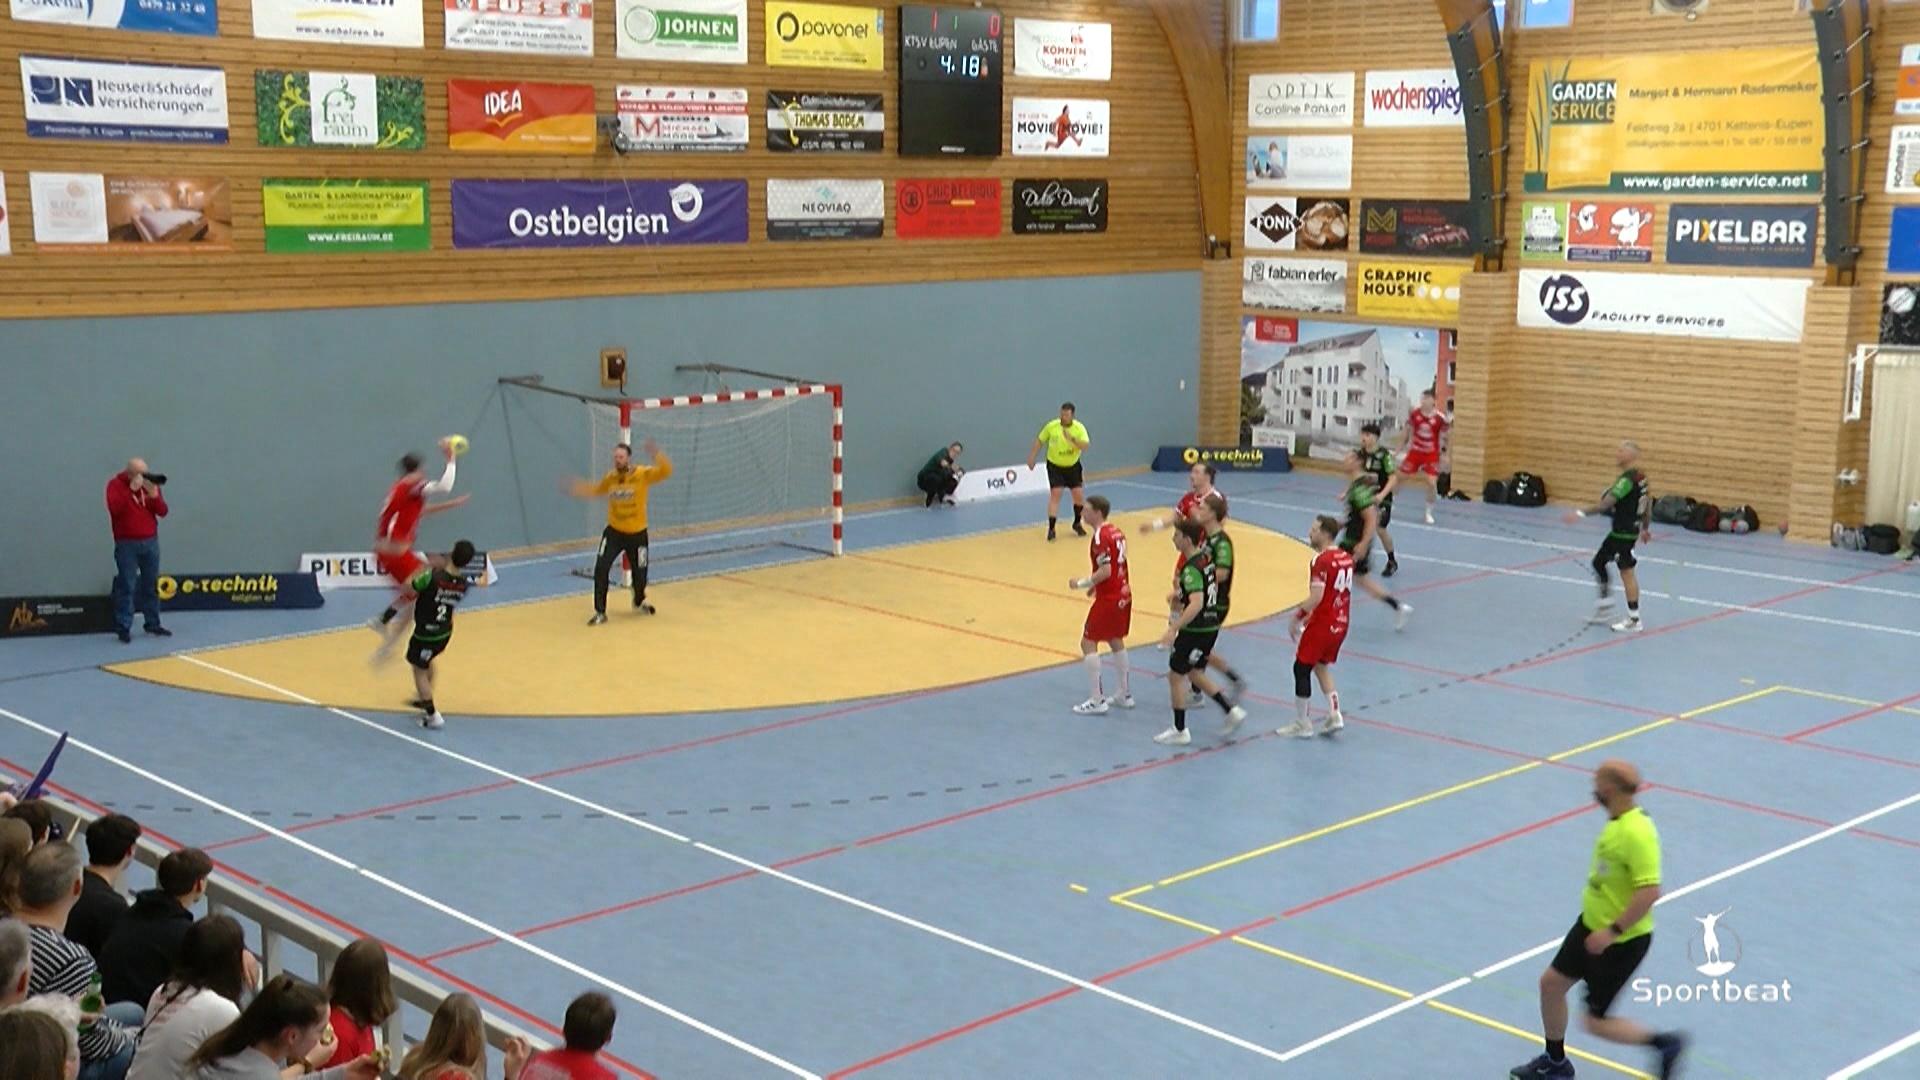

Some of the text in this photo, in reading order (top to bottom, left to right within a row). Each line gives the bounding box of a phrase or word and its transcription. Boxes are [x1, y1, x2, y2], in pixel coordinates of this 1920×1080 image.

[664, 17, 735, 37] JOHNEN
[802, 20, 868, 38] pavonet
[1268, 82, 1334, 101] OPTIK
[1552, 81, 1616, 101] GARDEN
[1629, 88, 1669, 100] Margot
[1672, 86, 1680, 97] &
[1683, 85, 1738, 97] Hermann
[97, 97, 205, 115] Versicherungen
[484, 88, 523, 116] IDEA
[1255, 103, 1301, 116] Caroline
[795, 112, 830, 127] THOMAS
[1552, 102, 1615, 121] SERVICE
[323, 124, 369, 137] raum
[1696, 120, 1721, 131] 4701
[1623, 173, 1808, 191] www.garden-service.net
[508, 206, 669, 243] Ostbelgien
[1675, 218, 1808, 244] PIXELBAR
[1364, 268, 1432, 283] GRAPHIC
[1364, 283, 1415, 296] HOUSE
[1544, 285, 1587, 312] ISS
[1591, 311, 1725, 328] FACILITY SERVICES
[182, 573, 278, 592] e-technik
